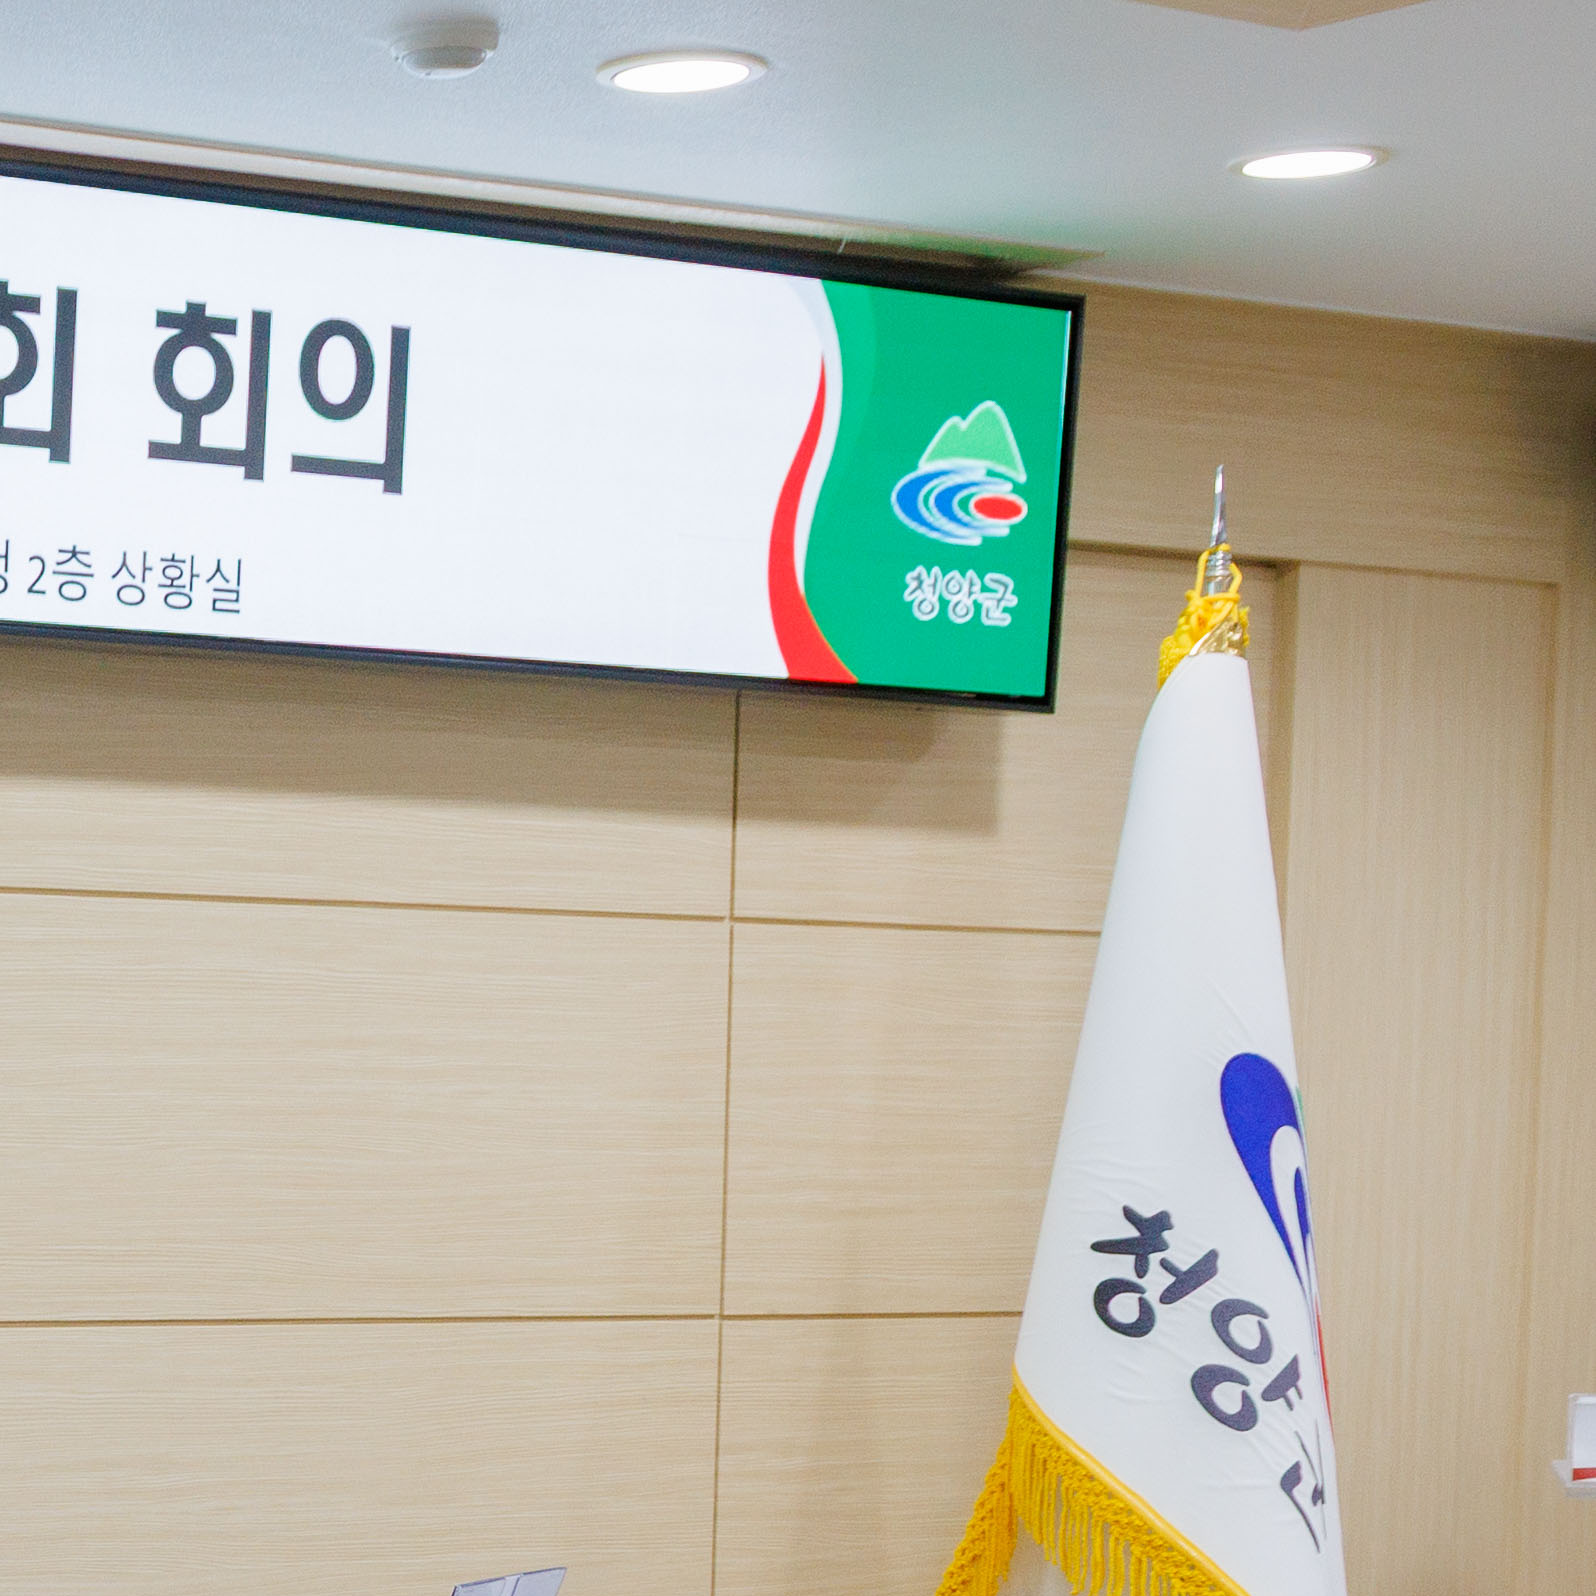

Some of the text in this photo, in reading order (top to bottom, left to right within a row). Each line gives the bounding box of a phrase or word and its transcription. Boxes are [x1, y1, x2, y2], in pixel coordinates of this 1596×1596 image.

[146, 300, 412, 496] 회의
[26, 543, 96, 603] 2층
[110, 550, 243, 615] 상황실
[903, 564, 1019, 627] 청양군
